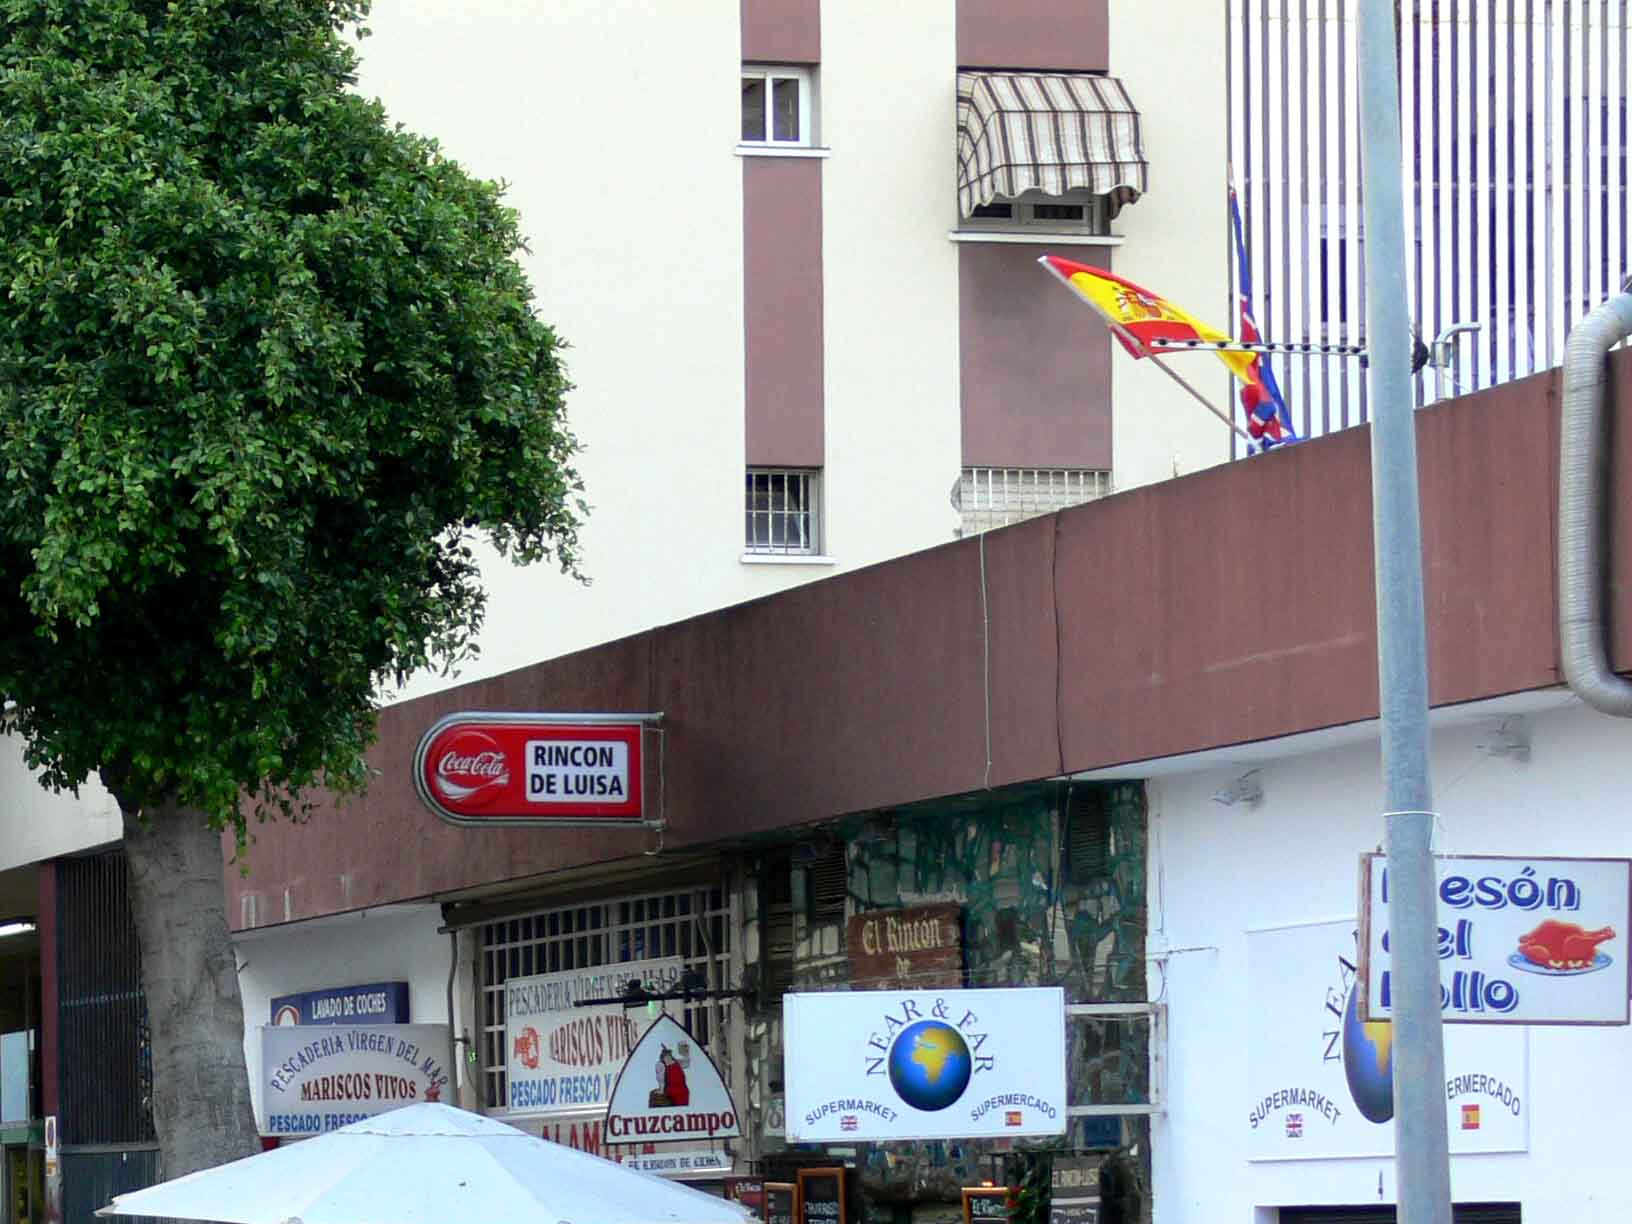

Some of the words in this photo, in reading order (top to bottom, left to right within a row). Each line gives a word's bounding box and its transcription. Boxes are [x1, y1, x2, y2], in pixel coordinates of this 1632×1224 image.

[534, 744, 614, 769] RINCON
[530, 773, 557, 796] DE
[564, 773, 624, 797] LUISA
[1381, 866, 1580, 910] esón
[862, 920, 883, 956] El
[885, 910, 944, 954] Rincón
[311, 997, 342, 1020] LAVADO
[344, 996, 355, 1016] DE
[355, 992, 388, 1014] COCHES
[1322, 928, 1361, 1064] NEA
[865, 998, 924, 1077] NEAR
[931, 997, 951, 1020] &
[957, 1009, 995, 1075] FAR
[270, 1034, 344, 1093] PESCADERIA
[347, 1029, 396, 1055] VIRGEN
[397, 1040, 421, 1067] DEL
[419, 1056, 449, 1086] MAR
[300, 1072, 372, 1101] MARISCOS
[375, 1073, 417, 1101] VIVOS
[510, 1077, 557, 1108] PESCADO
[558, 1074, 601, 1106] FRESCO
[603, 1072, 612, 1104] Y
[804, 1098, 899, 1126] SUPERMARKET
[970, 1092, 1057, 1122] SUPERMERCADO
[1248, 1086, 1342, 1130] SUPERMARKET
[269, 1113, 321, 1133] PESCADO
[608, 1111, 734, 1136] Cruzcampo
